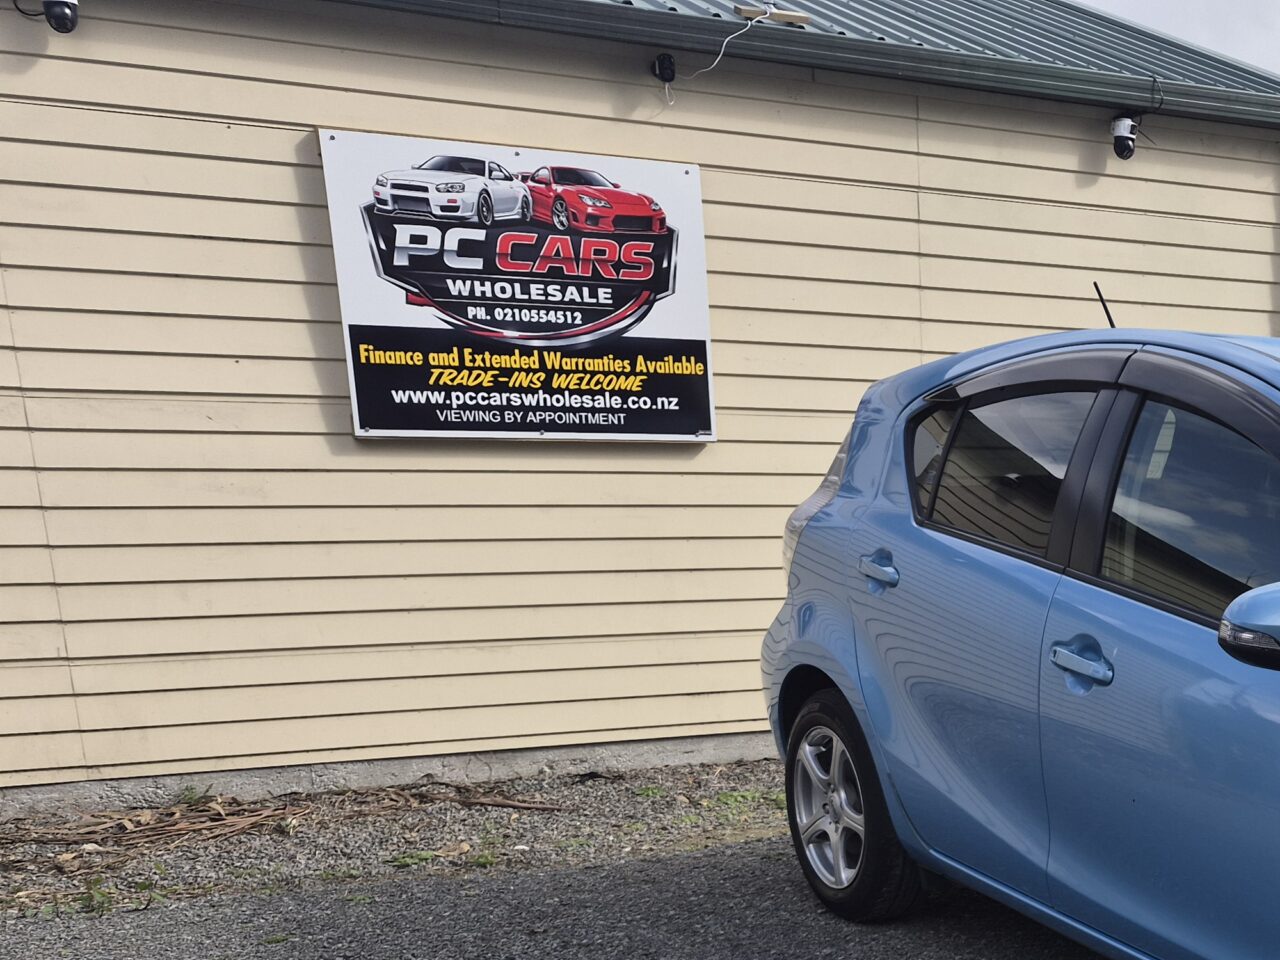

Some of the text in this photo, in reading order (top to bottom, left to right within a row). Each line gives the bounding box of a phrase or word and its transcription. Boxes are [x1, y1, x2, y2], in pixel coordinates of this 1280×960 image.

[392, 223, 655, 281] PC CARS
[445, 278, 613, 304] WHOLESALE
[467, 306, 583, 325] PH. 0210554512
[358, 343, 705, 375] Finance and Extended Warranties Available
[428, 368, 648, 392] TRADE-INS WELCOME
[391, 389, 680, 410] www.pccarswholesale.co.nz
[436, 409, 627, 425] VIEWING BY APPOINTMENT
